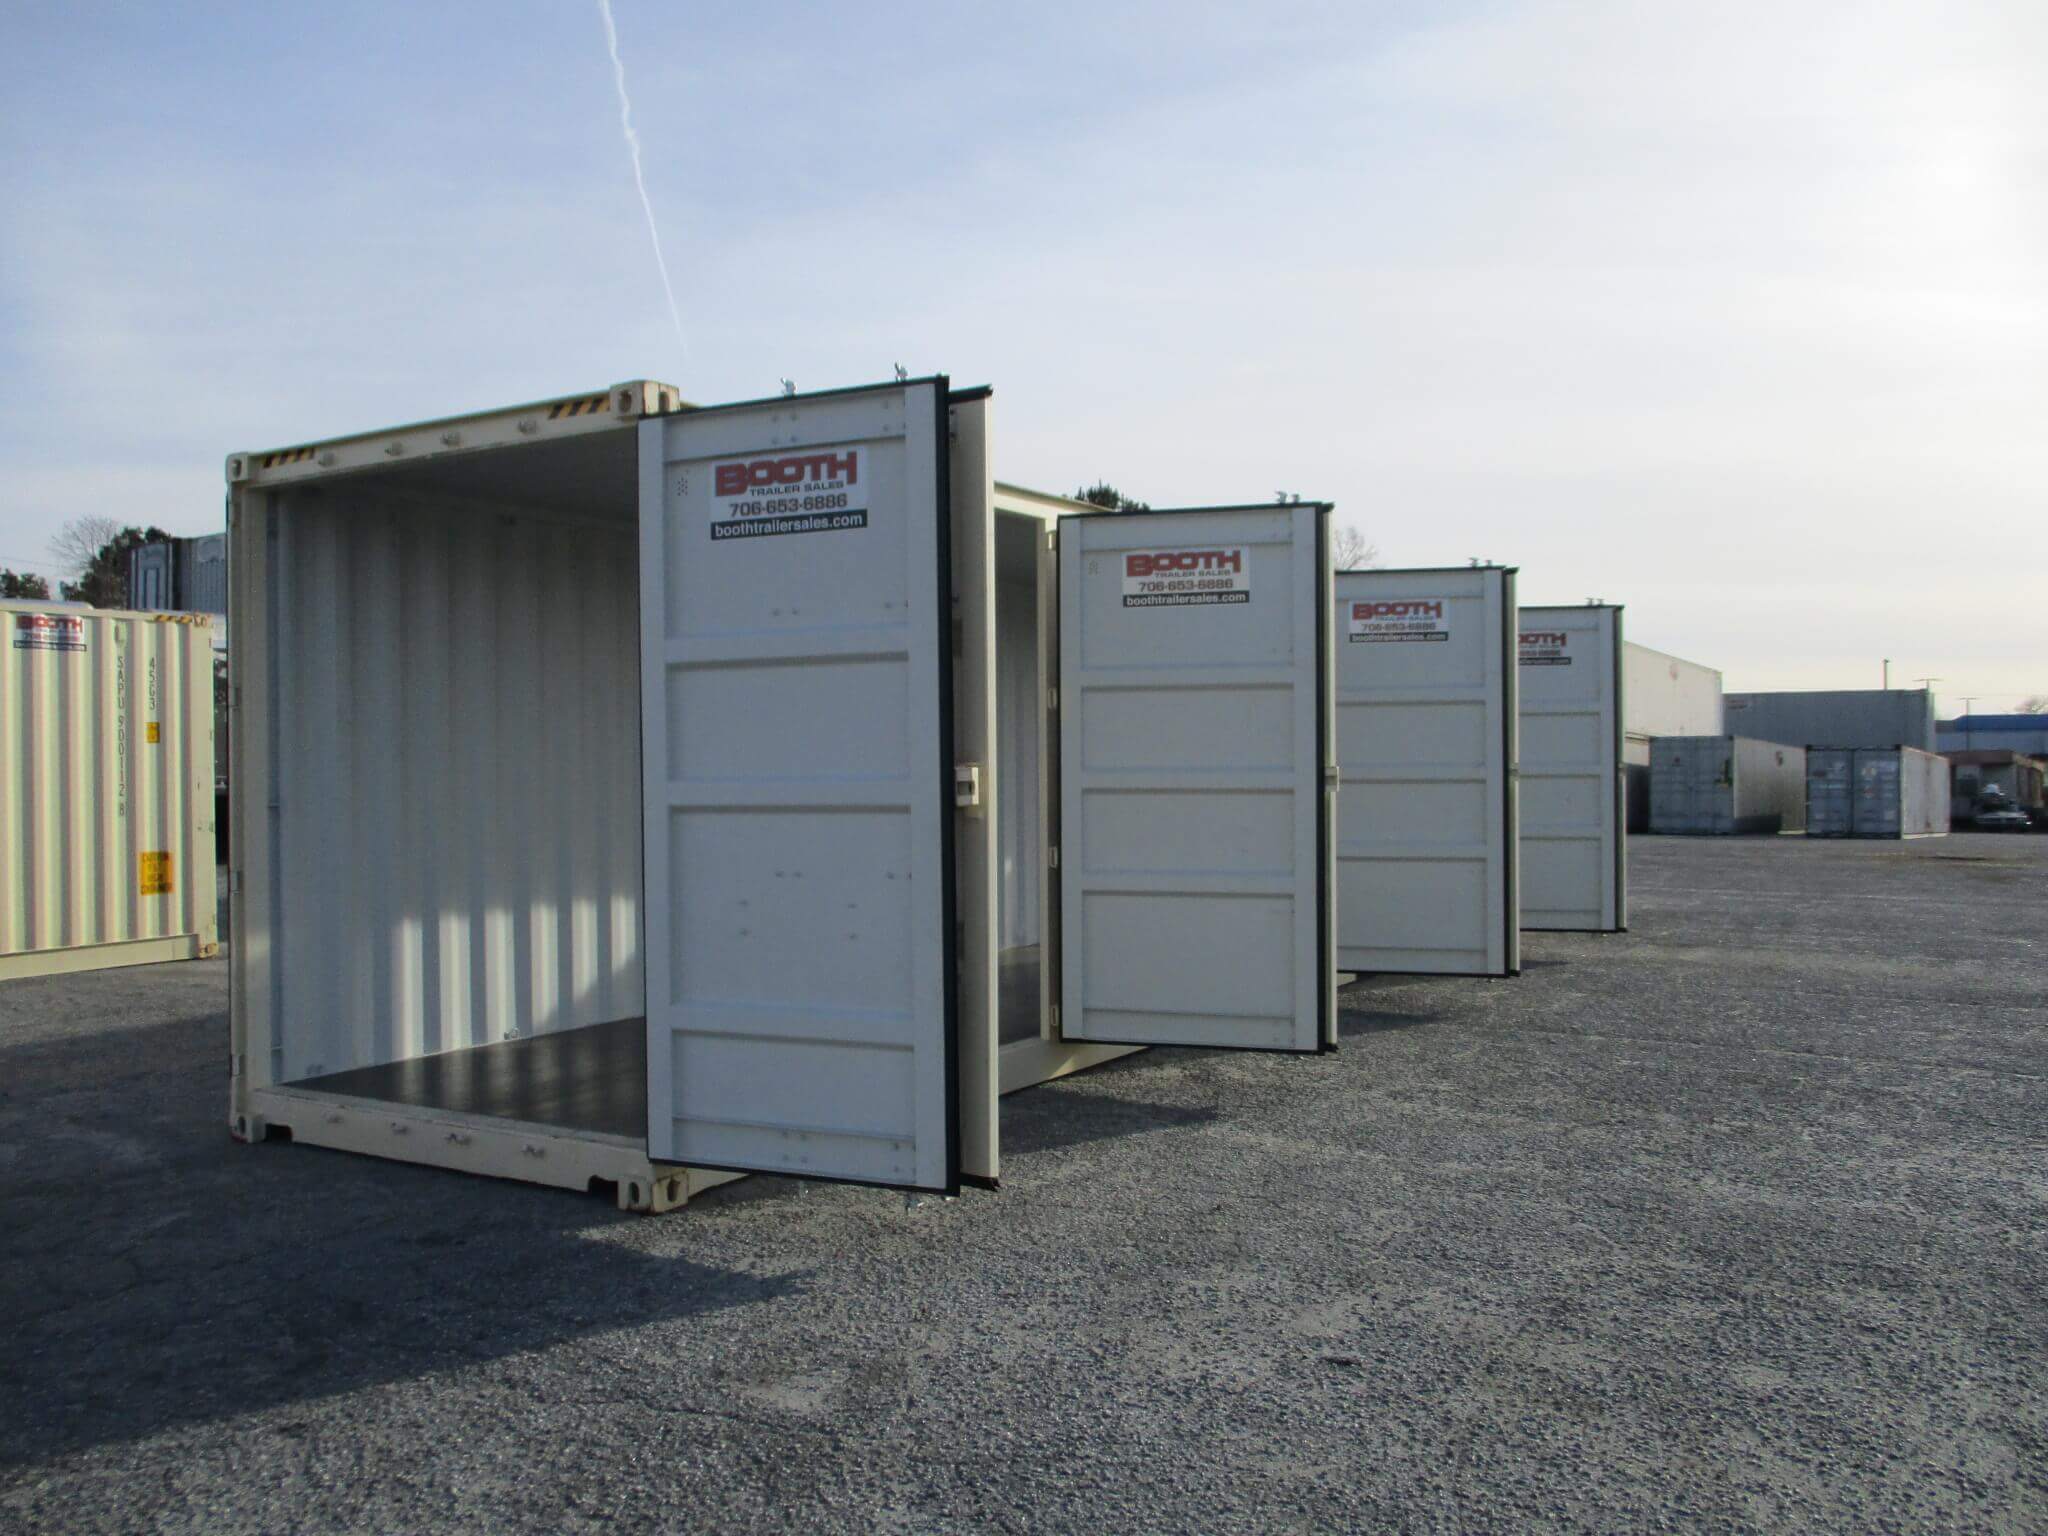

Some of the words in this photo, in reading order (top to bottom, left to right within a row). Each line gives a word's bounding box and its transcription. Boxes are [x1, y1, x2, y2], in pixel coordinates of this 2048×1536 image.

[715, 450, 857, 496] BOOTH
[750, 483, 800, 496] TRAILER
[804, 480, 844, 492] SALES
[729, 493, 848, 517] 706-653-6886
[715, 513, 863, 537] boothtrailersales.com
[1126, 549, 1241, 577] BOOTH
[1155, 570, 1195, 578] TRAILER
[1198, 569, 1231, 577] SALES
[1126, 592, 1247, 607] boothtrailersales.com
[1352, 601, 1442, 620] BOOTH
